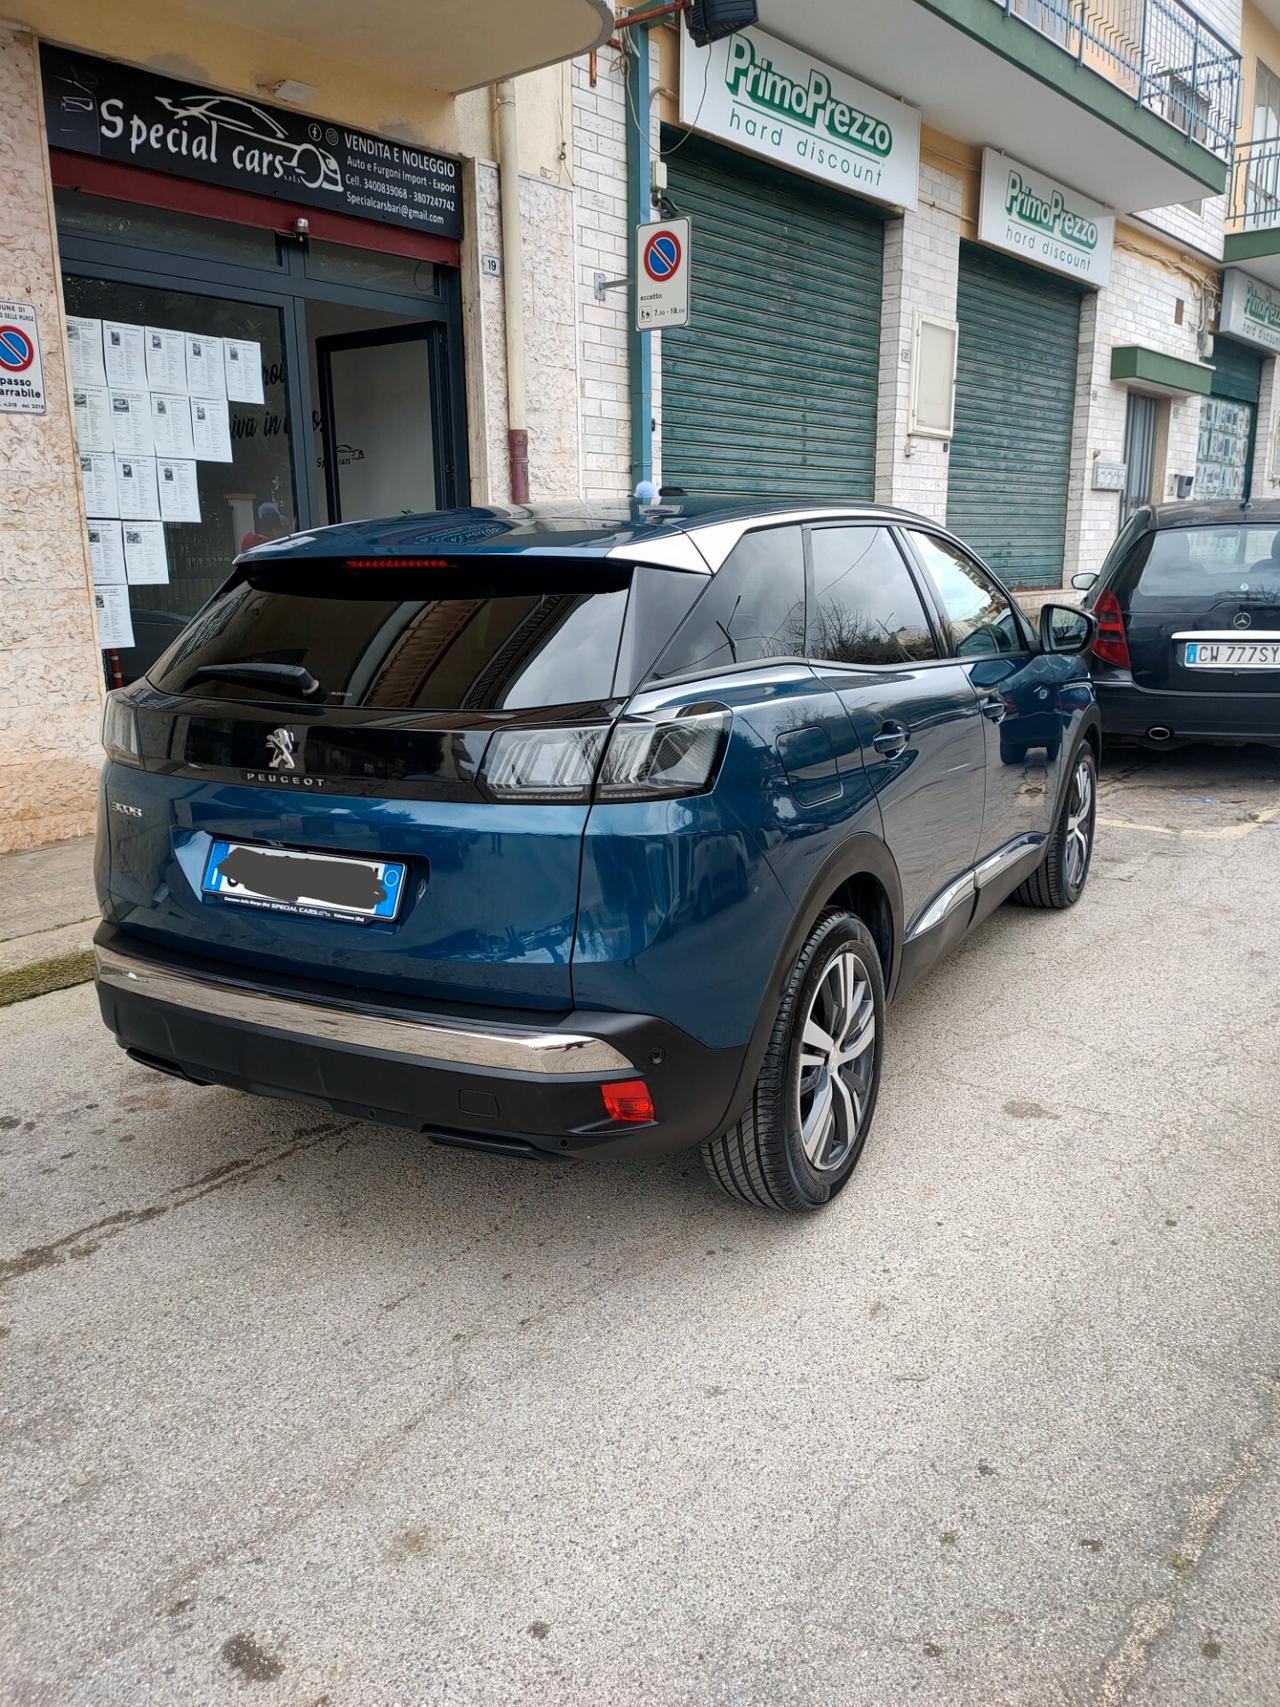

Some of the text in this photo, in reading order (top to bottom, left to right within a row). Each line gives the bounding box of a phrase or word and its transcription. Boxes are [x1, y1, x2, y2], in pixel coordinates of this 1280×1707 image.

[725, 32, 893, 158] PrimoPrezzo
[100, 99, 284, 178] Special cars
[344, 132, 455, 178] VENDITA E NOLEGGIO
[729, 108, 882, 186] hard discount
[347, 155, 365, 169] Auto
[367, 162, 372, 171] e
[373, 162, 401, 179] Furgoni
[402, 170, 427, 186] Import
[433, 178, 456, 194] Export
[345, 174, 361, 187] Cell.
[364, 178, 408, 199] 3400839068
[413, 191, 455, 212] 3807247742
[346, 191, 444, 224] Specialcarsbari@gmail.com
[1005, 169, 1098, 249] PrimoPrezzo
[488, 260, 496, 271] 19
[1006, 226, 1091, 272] hard discount
[0, 304, 16, 312] UNE
[640, 293, 663, 301] eccetto:
[4, 312, 18, 320] DELLE
[0, 377, 32, 387] passo
[1199, 646, 1220, 662] CW
[1226, 647, 1280, 663] 777SY
[246, 772, 326, 788] PEUGEOT
[271, 902, 298, 913] SPECIAL
[299, 906, 318, 915] CARS
